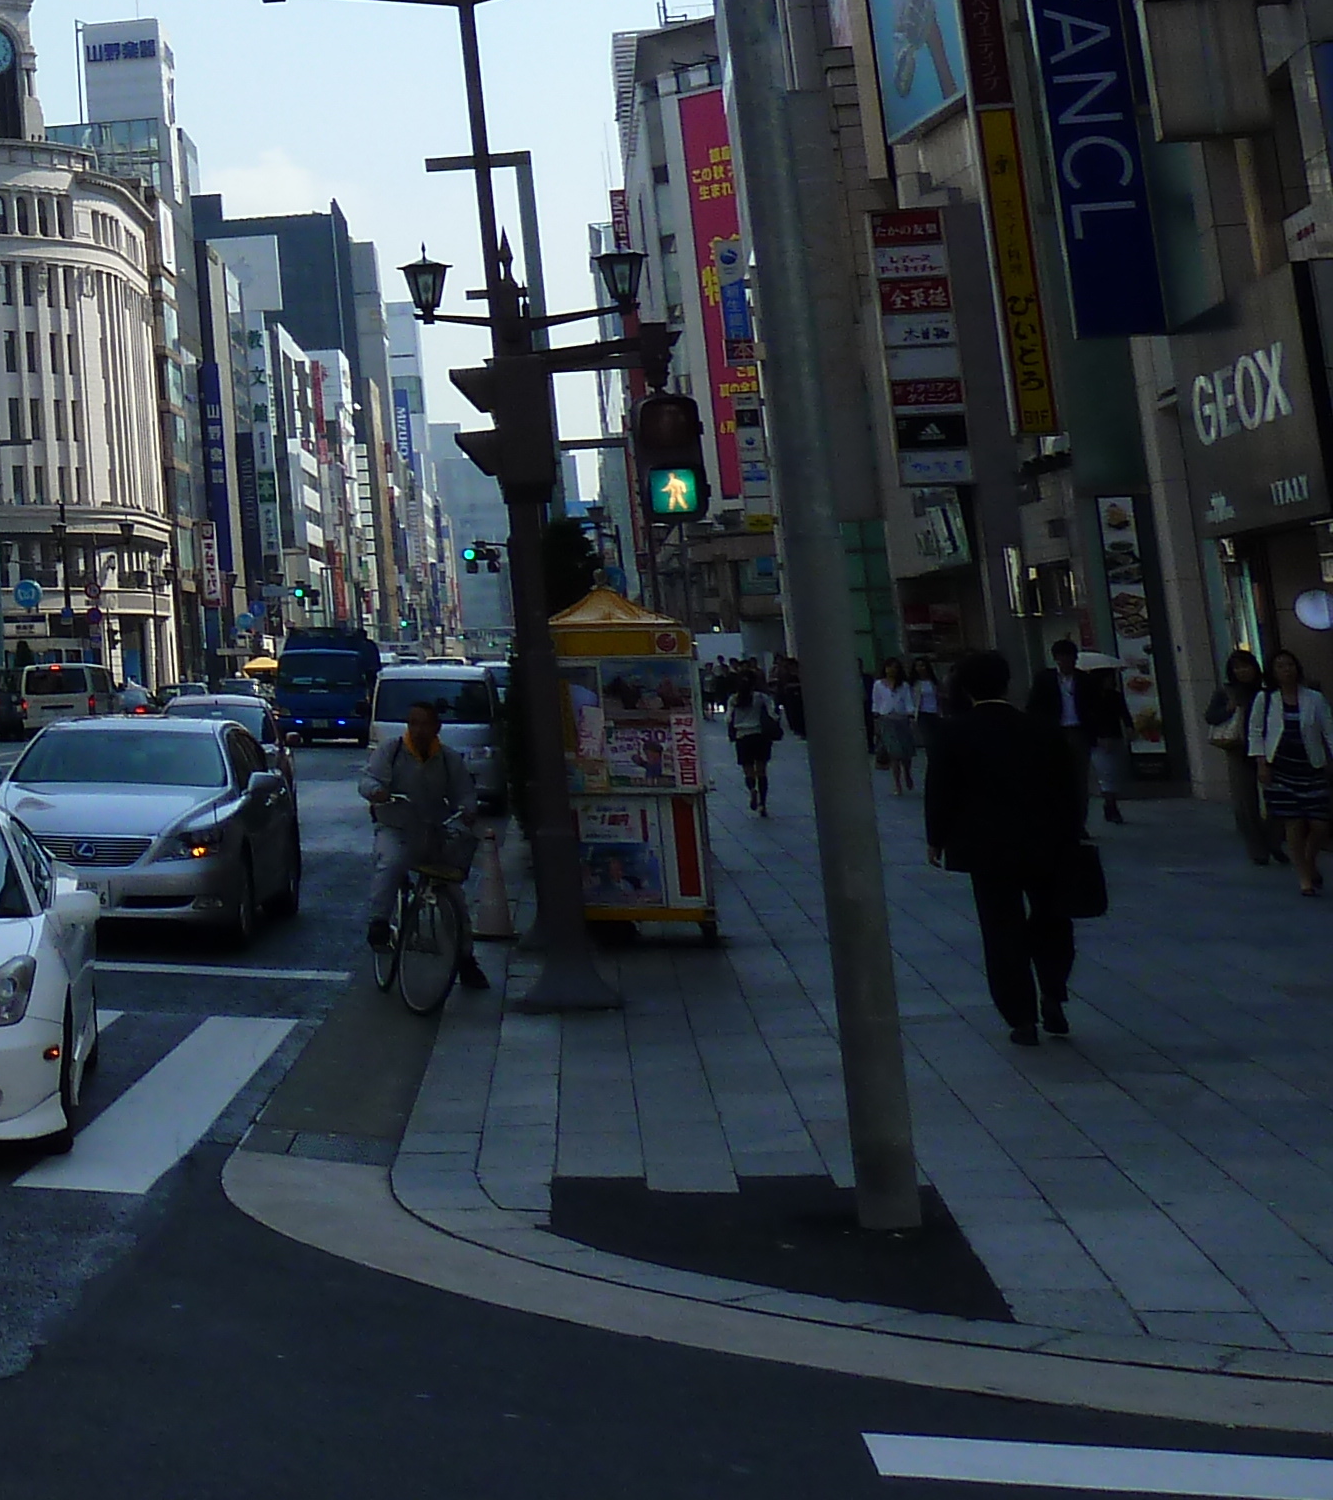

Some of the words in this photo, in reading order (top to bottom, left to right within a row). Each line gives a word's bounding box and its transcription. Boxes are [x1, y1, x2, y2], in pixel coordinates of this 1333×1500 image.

[1194, 341, 1293, 446] GEOX
[1270, 475, 1310, 506] ITALY
[675, 729, 698, 786] 大安吉日
